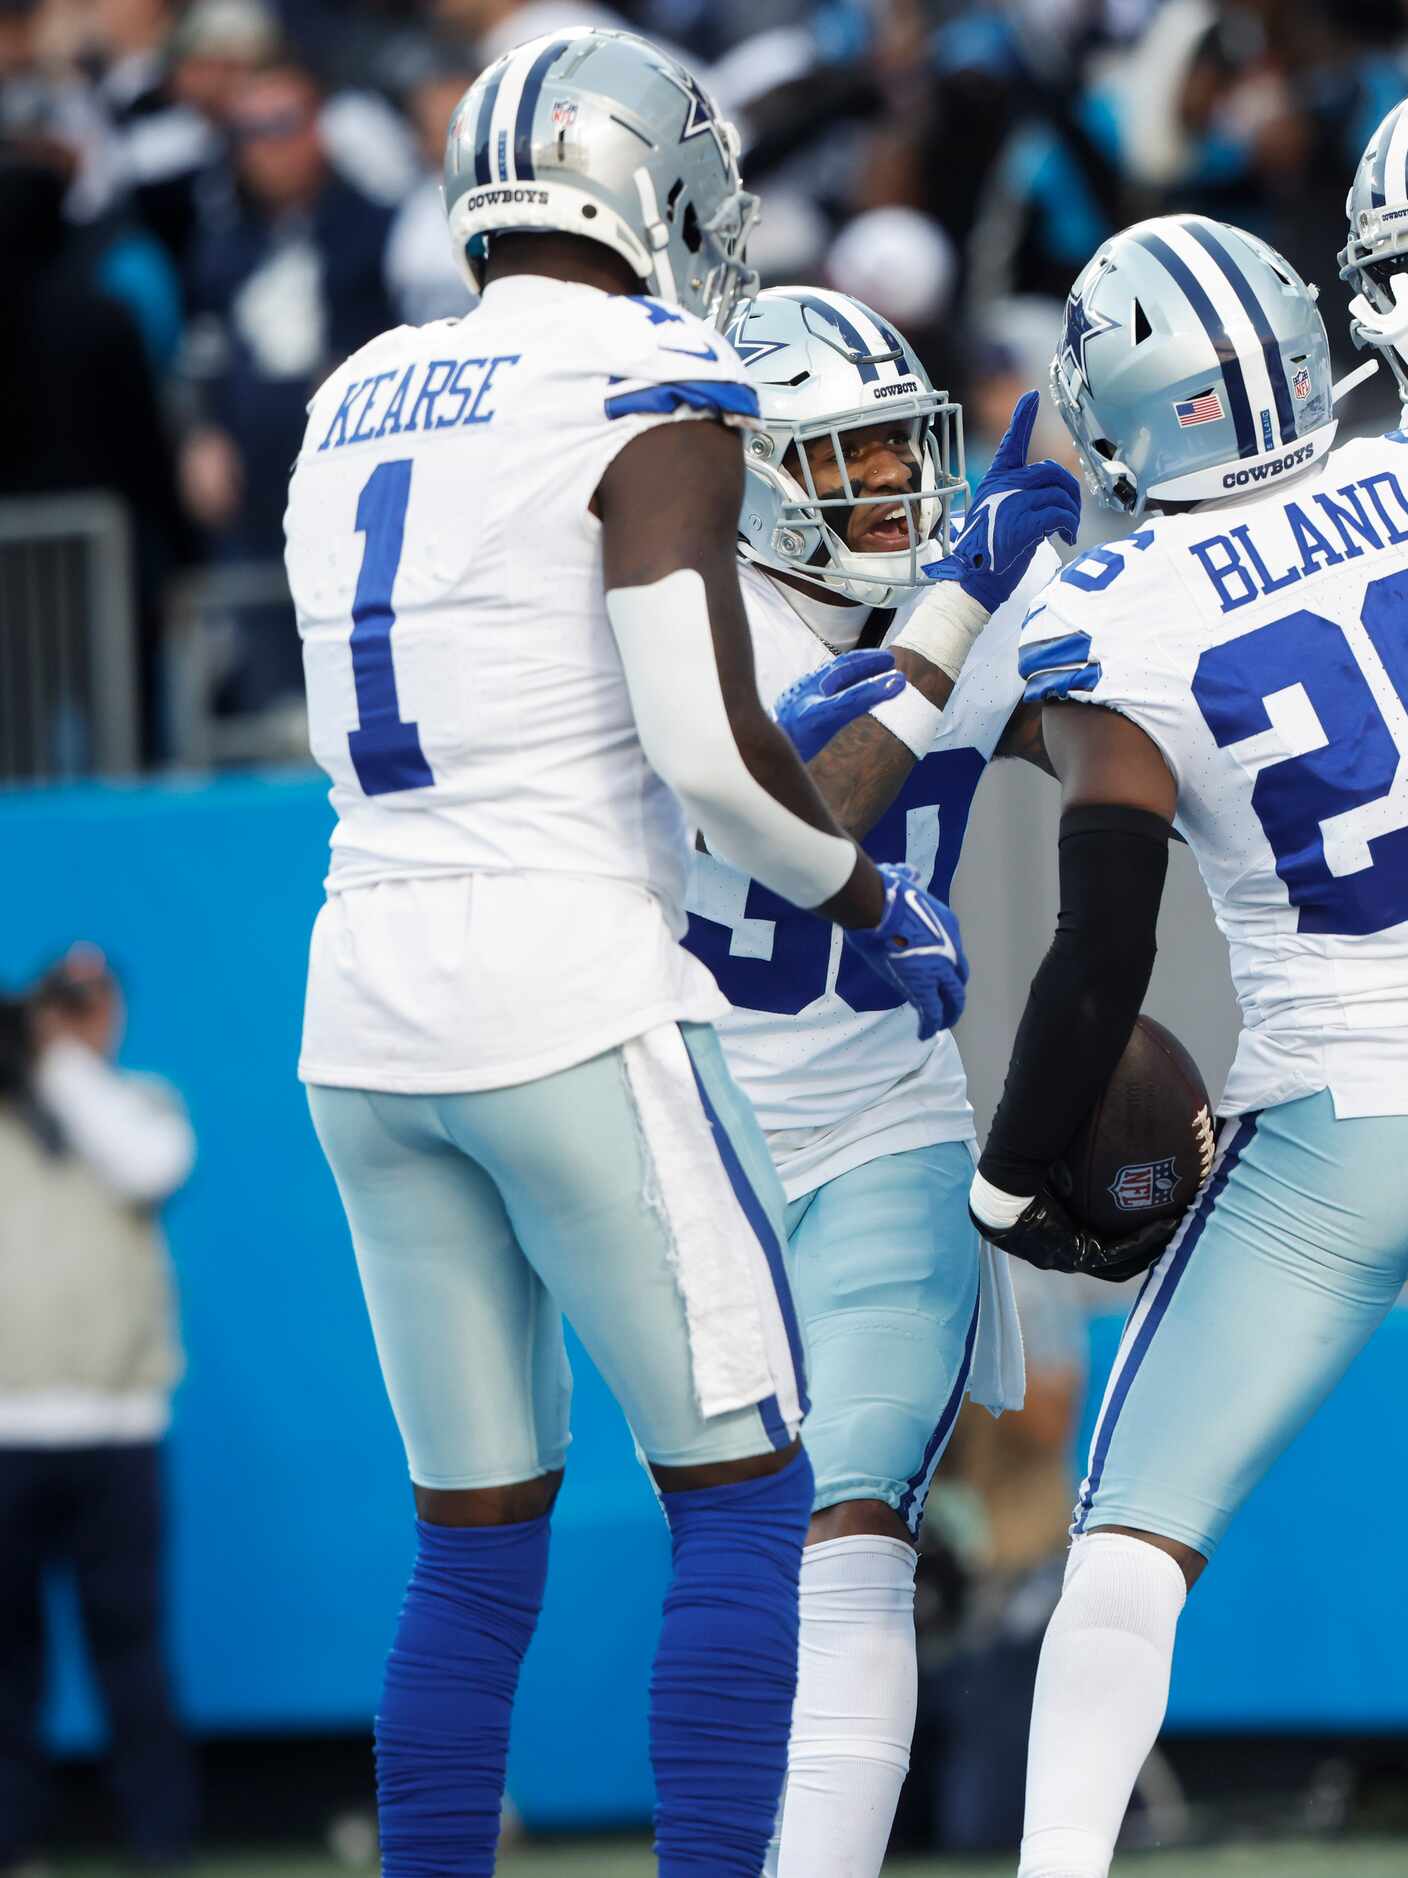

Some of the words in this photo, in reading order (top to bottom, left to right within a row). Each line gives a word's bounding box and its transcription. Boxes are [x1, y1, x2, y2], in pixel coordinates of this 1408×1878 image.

[468, 189, 549, 211] COWBOYS
[317, 354, 522, 452] KEARSE
[873, 381, 918, 399] COWBOYS
[1222, 442, 1314, 488] COWBOYS
[347, 458, 435, 796] 1
[1119, 1167, 1153, 1206] NFL
